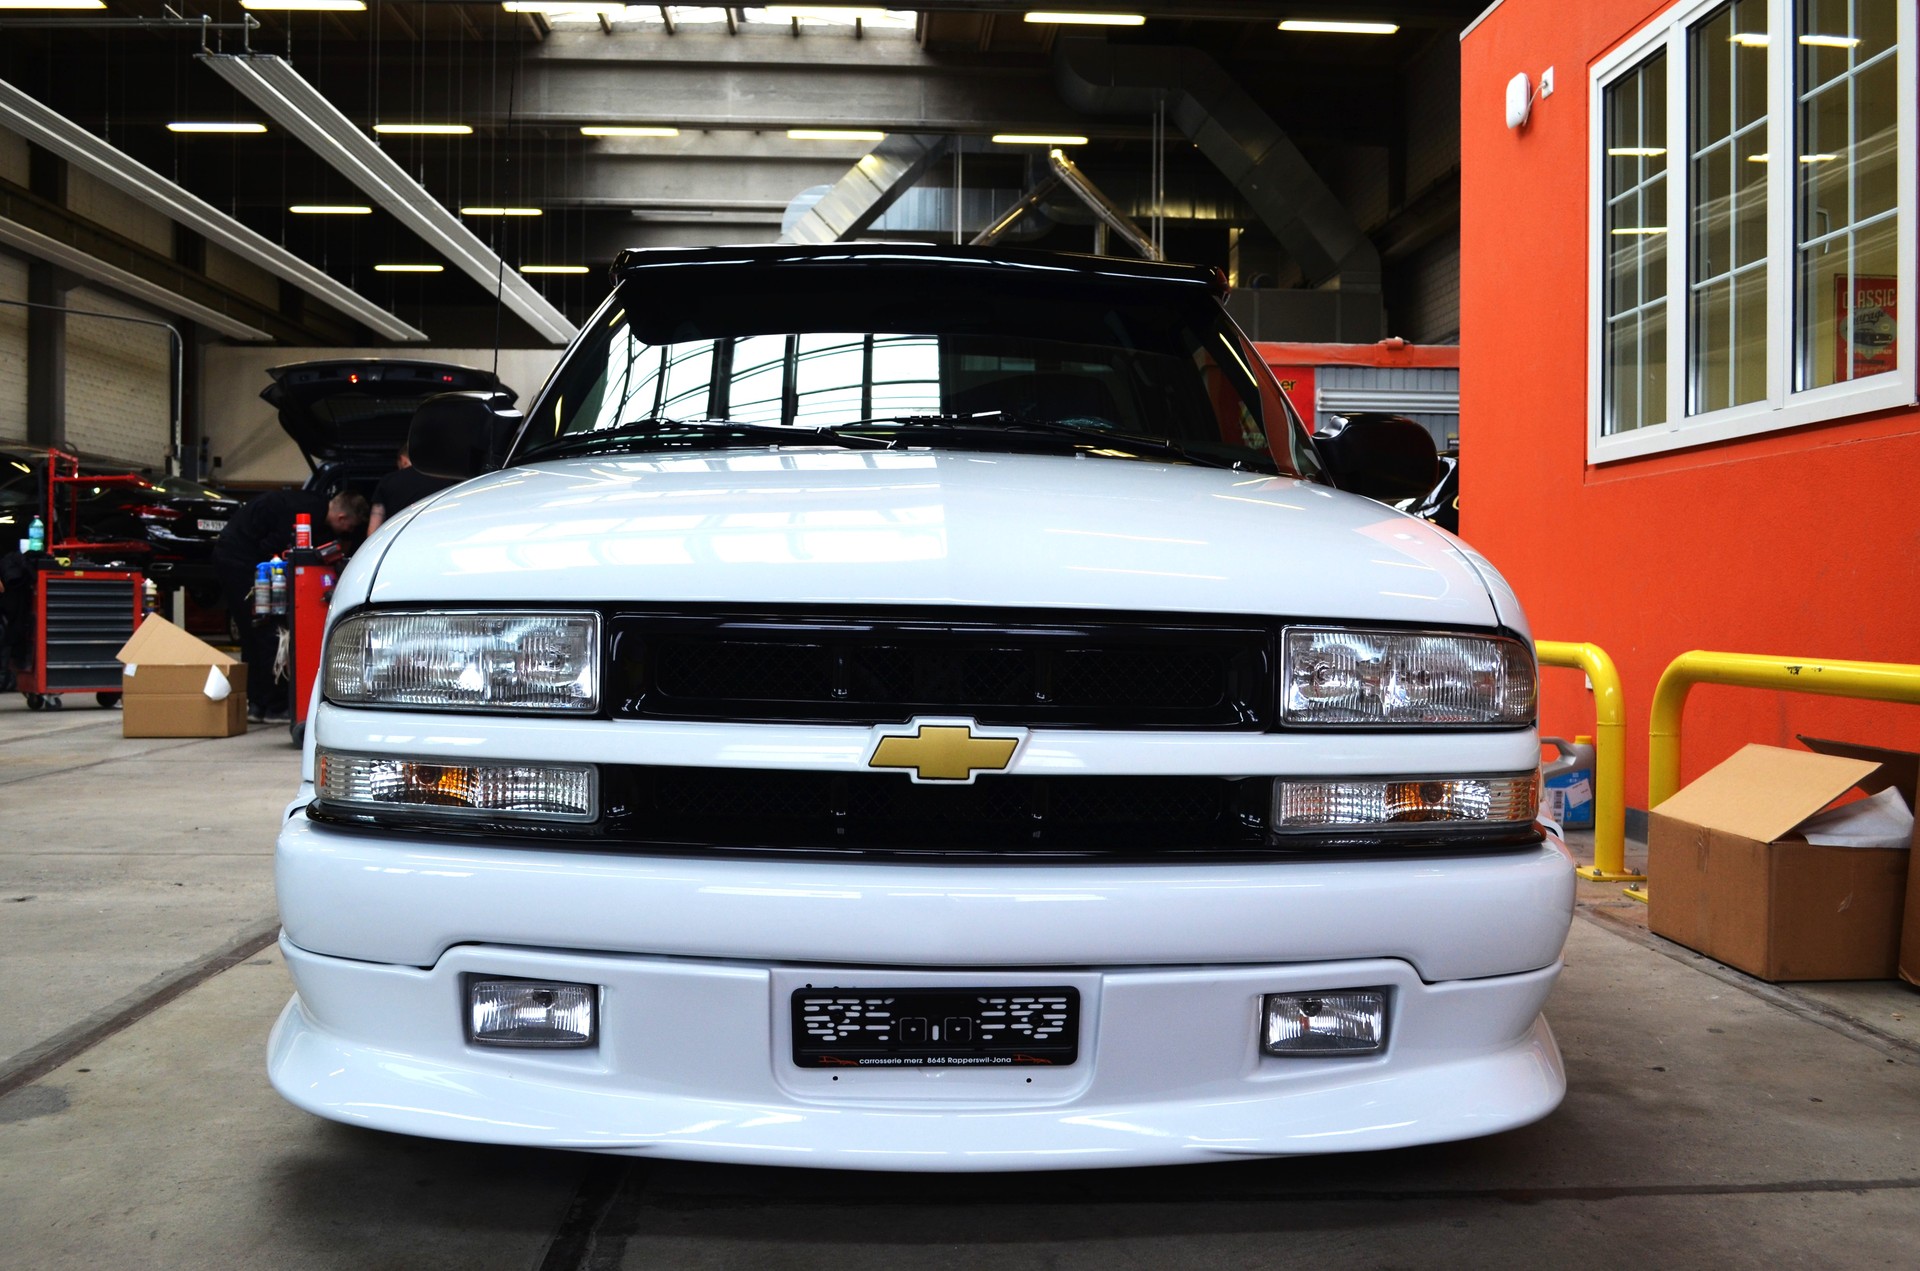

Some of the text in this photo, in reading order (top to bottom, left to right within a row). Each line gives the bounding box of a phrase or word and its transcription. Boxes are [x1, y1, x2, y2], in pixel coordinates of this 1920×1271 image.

[1842, 288, 1896, 309] CASSIC
[859, 1057, 902, 1065] carrosserie
[926, 1057, 946, 1065] 8645
[947, 1056, 1012, 1065] Rapperswil-Jona
